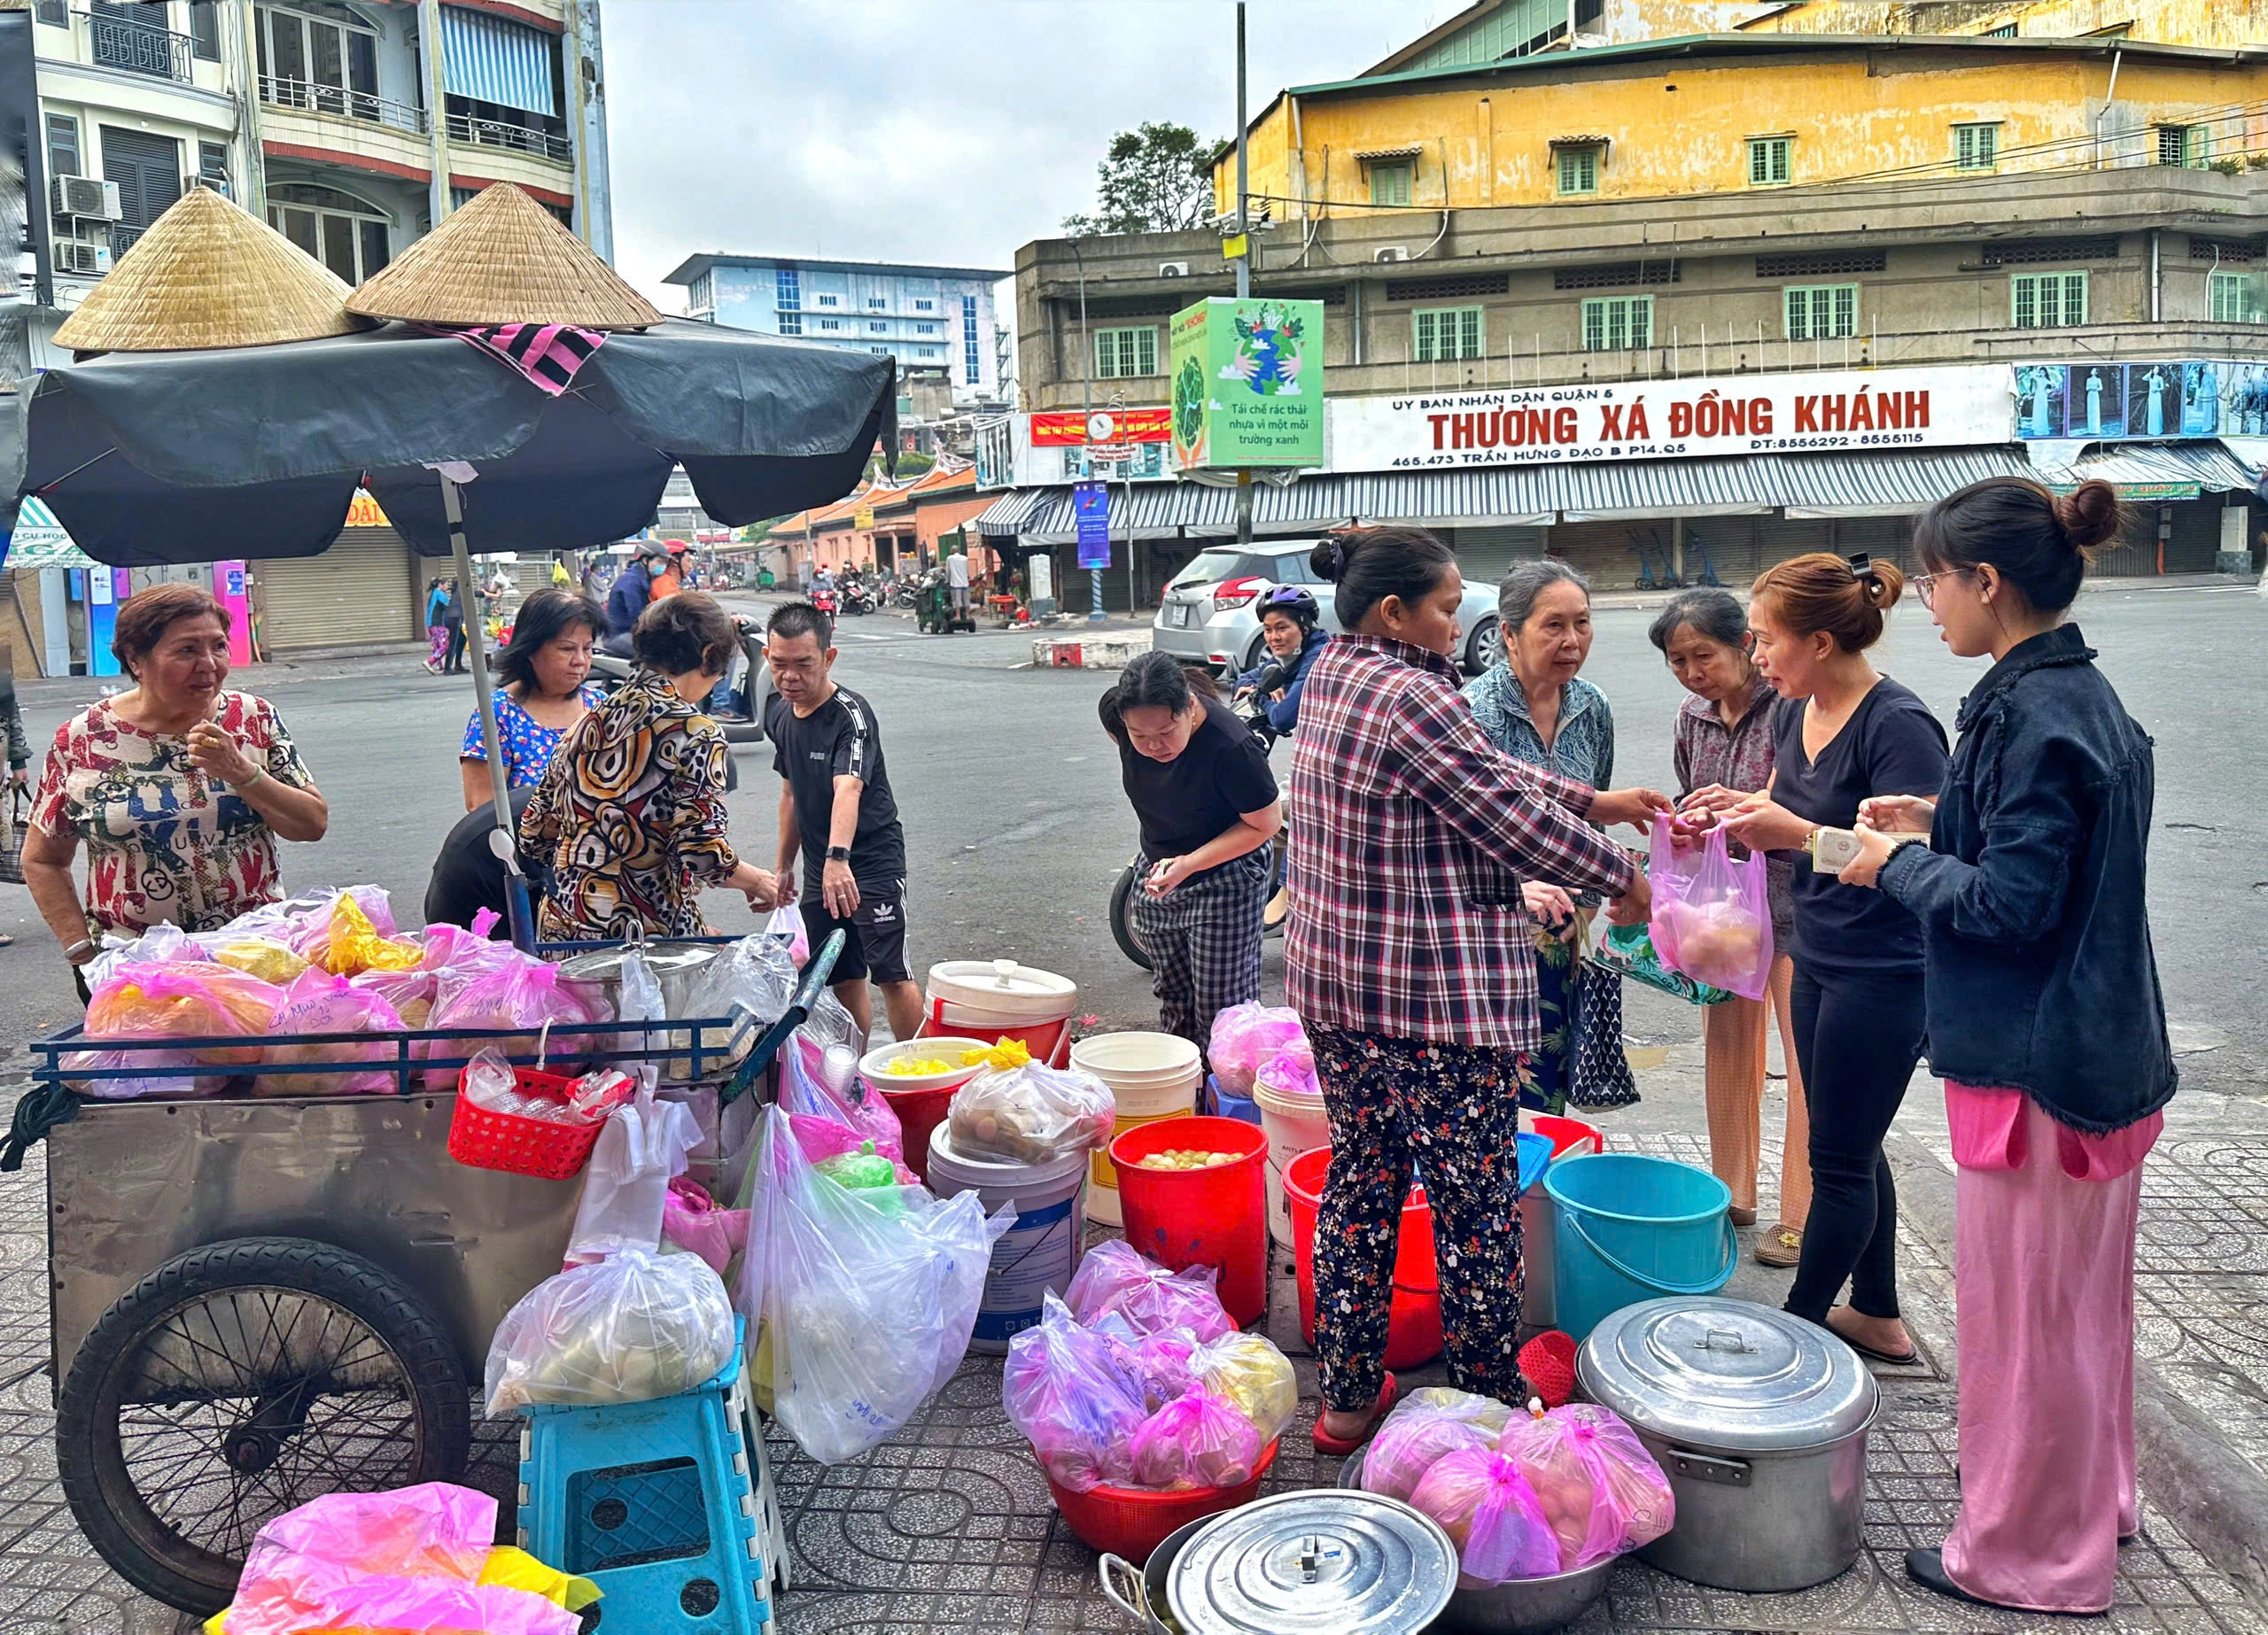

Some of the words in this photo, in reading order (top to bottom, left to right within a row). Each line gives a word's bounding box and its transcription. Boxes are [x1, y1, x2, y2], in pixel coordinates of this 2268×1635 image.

[1420, 398, 1453, 408] BAN
[1459, 394, 1504, 407] NHÂN
[1511, 391, 1544, 404] DÂN
[1551, 389, 1598, 402] QUẬN
[1604, 389, 1613, 399] 5
[1231, 403, 1247, 415] Tái
[1249, 403, 1267, 415] chế
[1270, 403, 1285, 415] rác
[1287, 403, 1307, 415] thải
[1427, 404, 1578, 450] THƯƠNG
[1599, 395, 1650, 441] XÁ
[1668, 389, 1773, 438] ĐỒNG
[1794, 384, 1930, 433] KHÁNH
[1229, 419, 1254, 431] nhựa
[1256, 418, 1265, 430] vì
[1268, 418, 1288, 432] một
[1290, 419, 1309, 430] môi
[1239, 433, 1272, 446] trường
[1275, 435, 1299, 445] xanh
[1751, 437, 1849, 449] ĐT:8556292
[1860, 433, 1923, 445] 8555115
[1514, 449, 1561, 461] HƯNG
[1569, 447, 1603, 460] ĐẠO
[1611, 446, 1621, 455] B
[1628, 444, 1686, 455] P14.Q5
[852, 737, 861, 761] PUMA
